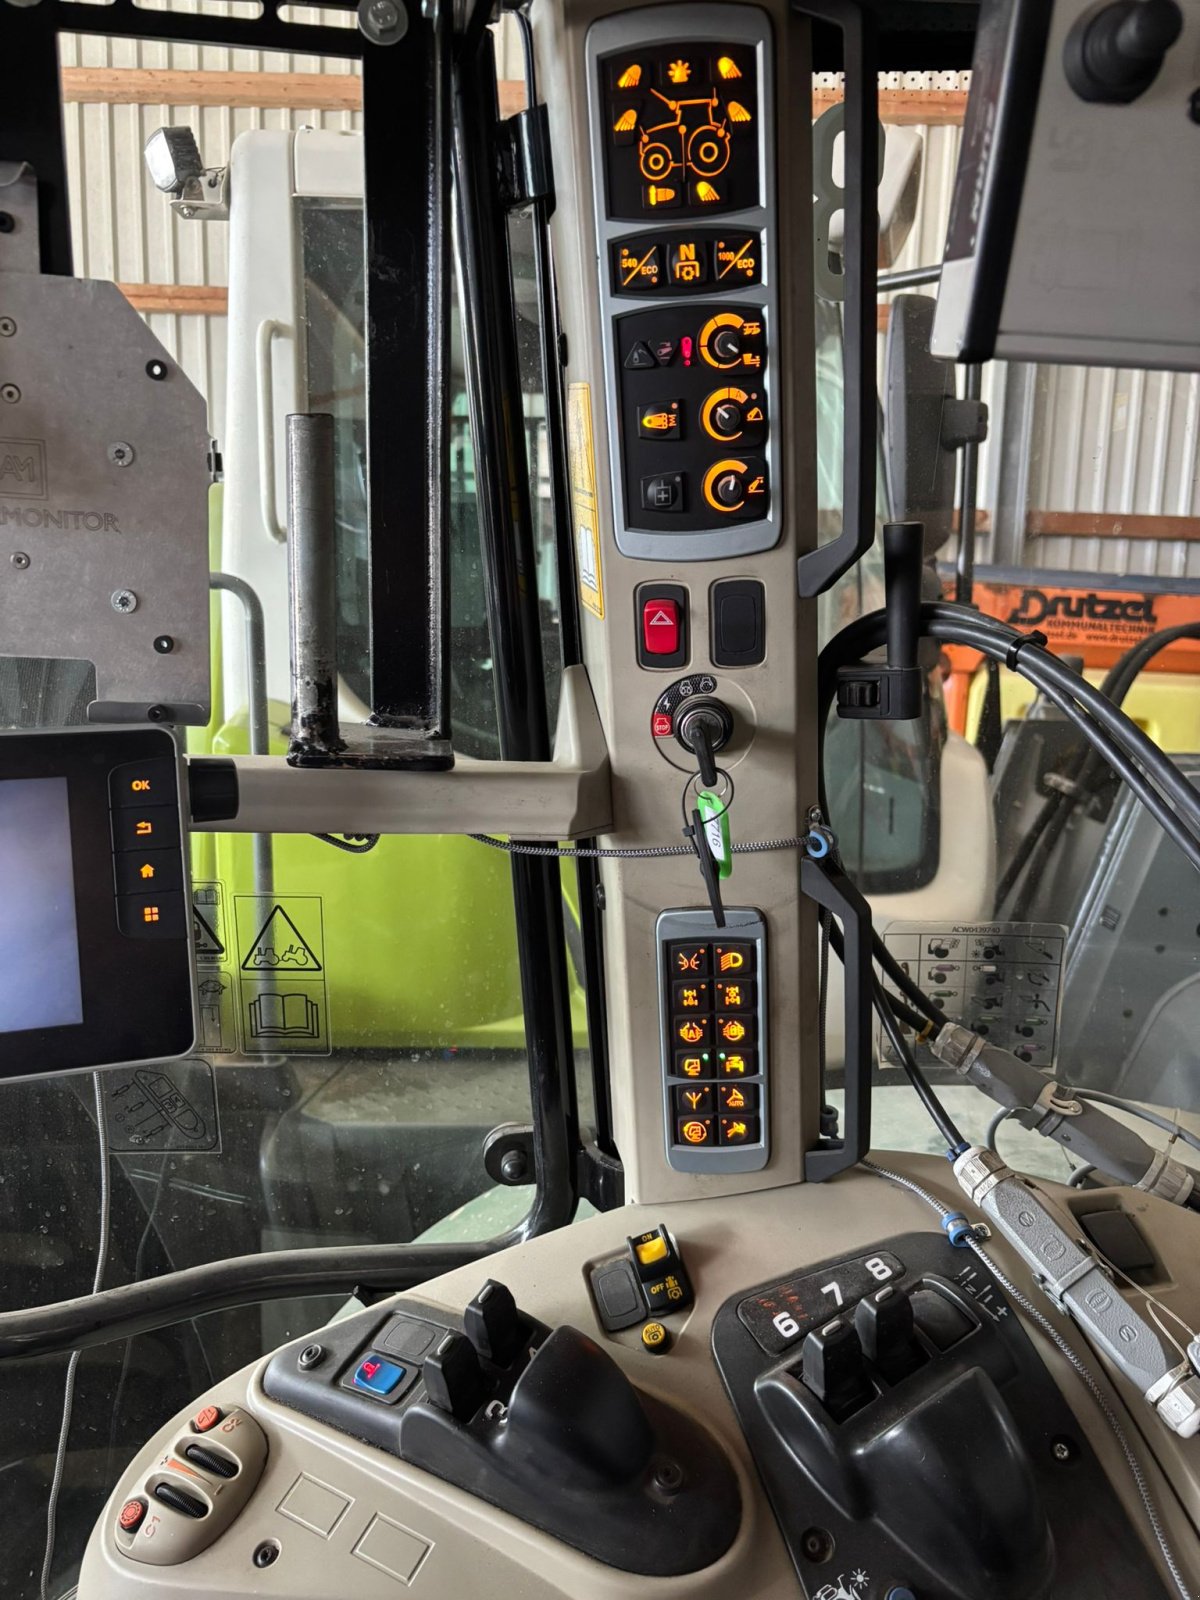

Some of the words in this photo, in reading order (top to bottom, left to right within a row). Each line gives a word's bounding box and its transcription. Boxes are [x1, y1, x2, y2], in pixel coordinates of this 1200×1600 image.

[680, 244, 695, 260] N
[718, 251, 735, 261] 1000
[621, 258, 638, 268] 540
[737, 258, 755, 269] ECO
[641, 265, 658, 275] ECO
[0, 506, 121, 534] MONITOR
[132, 780, 151, 791] OK
[641, 1232, 653, 1243] ON
[865, 1257, 893, 1281] 8
[650, 1282, 665, 1295] OFF
[820, 1281, 844, 1307] 7
[772, 1311, 800, 1338] 6
